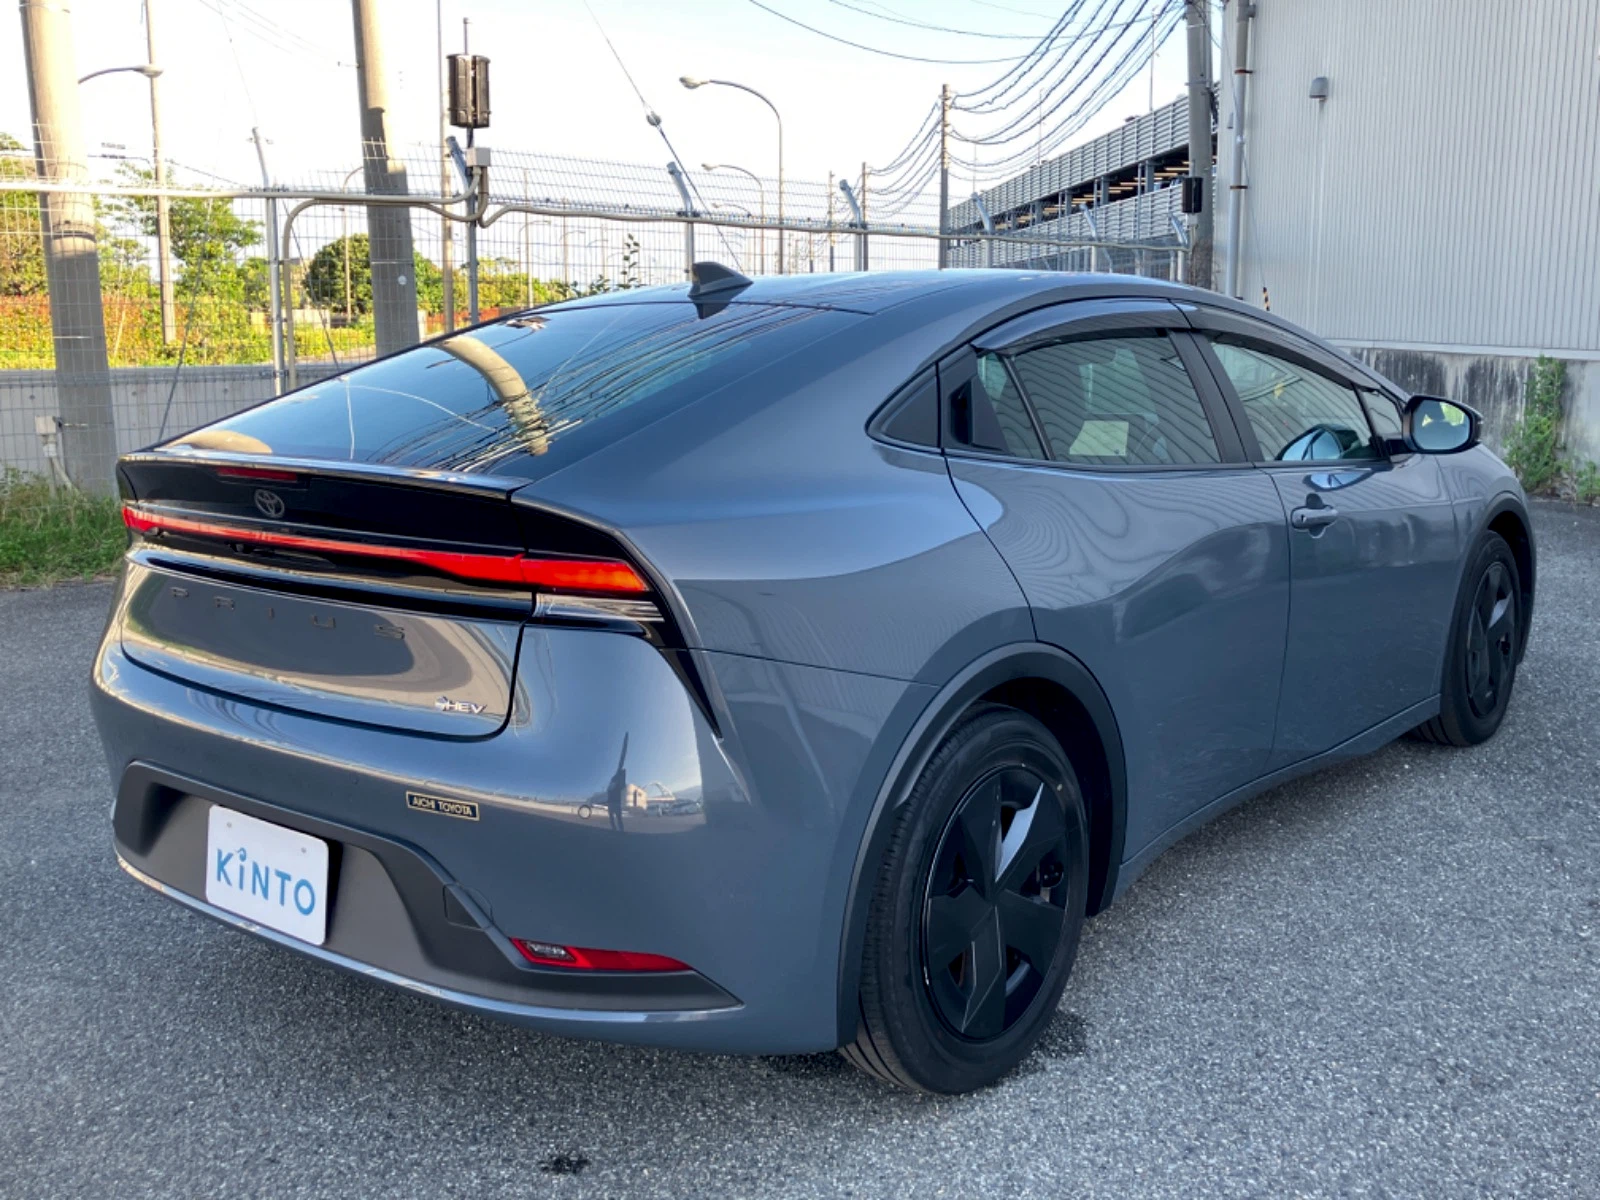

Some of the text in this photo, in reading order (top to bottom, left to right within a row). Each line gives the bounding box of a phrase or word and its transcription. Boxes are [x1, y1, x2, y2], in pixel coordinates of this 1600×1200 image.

[170, 586, 405, 640] PRIUS
[441, 700, 486, 714] HEV
[438, 801, 473, 816] TOYOTA
